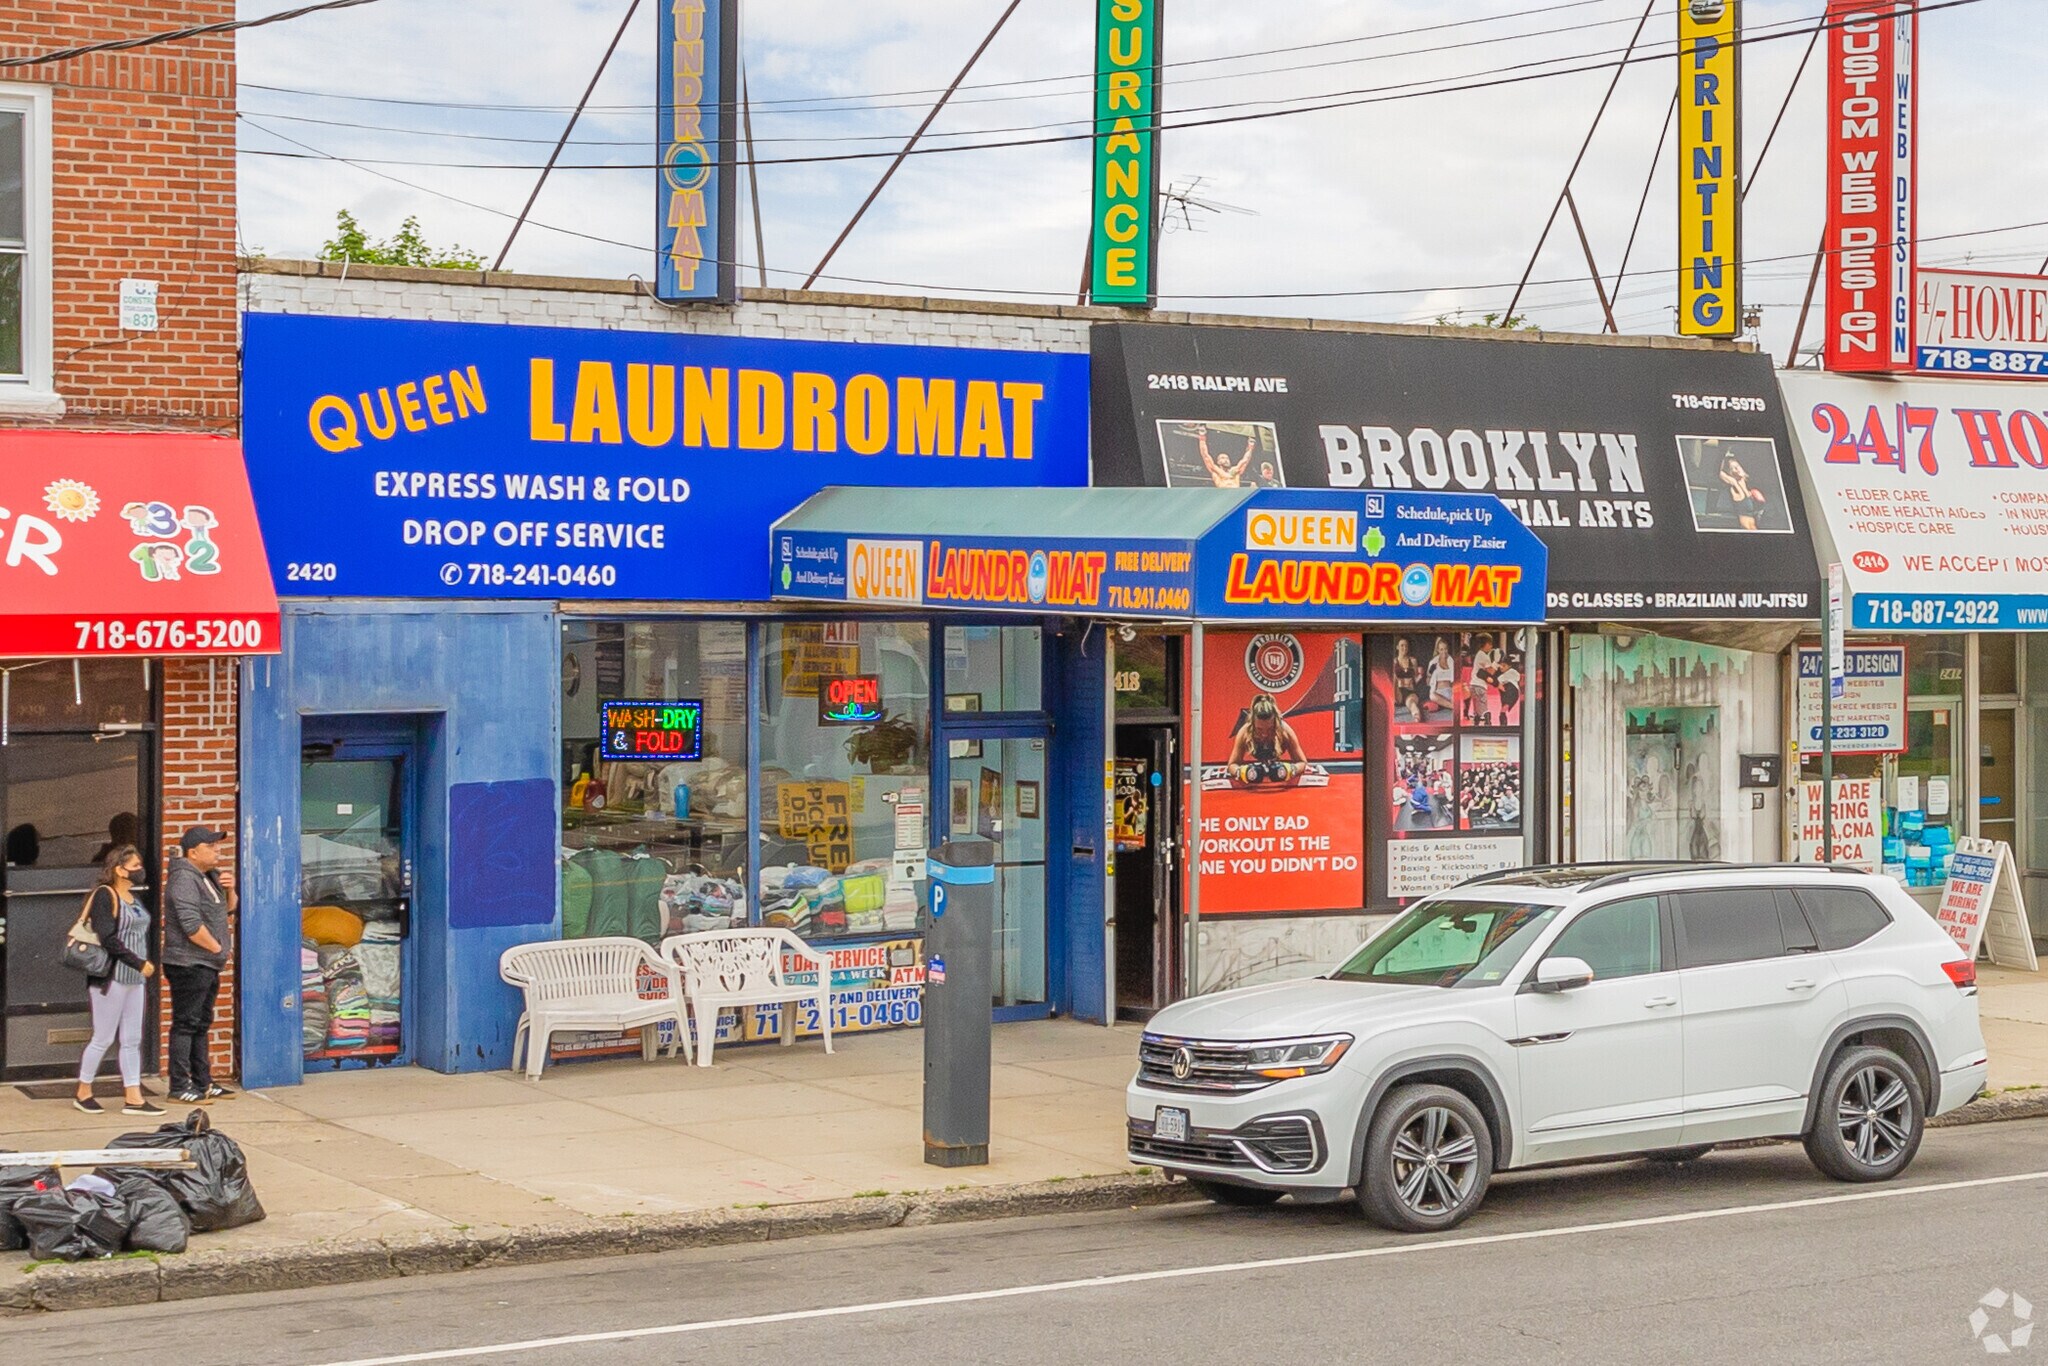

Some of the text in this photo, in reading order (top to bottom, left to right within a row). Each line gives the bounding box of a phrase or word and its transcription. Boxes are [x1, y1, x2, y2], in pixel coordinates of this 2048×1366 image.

[1896, 73, 1910, 159] WEB
[1692, 35, 1724, 327] PRINTING
[1839, 12, 1880, 353] CUSTOM WEB DESIGN
[1895, 177, 1908, 353] DESIGN
[1950, 284, 2048, 343] HOME
[1147, 374, 1288, 393] 2418 RALPH AVE
[308, 358, 1044, 460] QUEEN LAUNDROMAT
[1672, 394, 1766, 412] 718-677-5979
[1811, 402, 2048, 476] 24/7 HO
[1318, 425, 1645, 493] BROOKLYN
[375, 471, 690, 503] EXPRESS WASH & FOLD
[1845, 489, 1931, 502] ELDER CARE
[1475, 509, 1493, 526] Up
[1578, 499, 1655, 528] ARTS
[1851, 505, 1892, 517] HOME
[1893, 506, 1945, 519] HEALTH
[2021, 508, 2048, 520] NUR
[403, 519, 665, 549] DROP OFF SERVICE
[1249, 512, 1508, 552] QUEEN And Delivery Easier
[1857, 521, 1956, 535] HOSPICE CARE
[2011, 524, 2048, 536] HOUS
[0, 505, 62, 576] R
[287, 562, 337, 582] 2420
[852, 540, 1192, 605] QUEEN LAUNDROMAT FREE DELIVERY
[1856, 553, 1887, 570] 2414
[1903, 555, 1934, 572] WE
[467, 563, 617, 587] 718-241-0460
[1225, 553, 1521, 608] LAUNDROMAT
[1108, 586, 1191, 611] 718.241.0460
[1572, 593, 1644, 609] CLASSES
[1655, 593, 1736, 609] BRAZILIAN
[1739, 593, 1808, 609] JIU-JITSU
[1867, 599, 2000, 625] 718-887-2922
[75, 620, 262, 649] 718-676-5200
[1856, 654, 1899, 673] DESIGN
[829, 678, 878, 704] OPEN
[636, 730, 684, 753] FOLD
[1815, 726, 1885, 739] 7-233-3120
[1839, 782, 1871, 801] ARE
[1809, 801, 1869, 821] HRING
[1224, 816, 1270, 832] ONLY
[1274, 815, 1309, 830] BAD
[1280, 837, 1294, 851] IS
[1298, 836, 1331, 850] THE
[1434, 843, 1461, 851] Adults
[1464, 843, 1497, 851] Classes
[1832, 843, 1863, 860] PCA
[1229, 858, 1266, 874] YOU
[1271, 857, 1329, 872] DIDN'T
[1331, 856, 1358, 871] DO
[1400, 854, 1431, 862] Private
[1951, 880, 1965, 893] WE
[934, 885, 944, 913] P
[851, 968, 887, 980] WEEK
[840, 991, 863, 1005] AND
[867, 986, 921, 1003] DELIVERY
[755, 1000, 921, 1036] 71-21-0460
